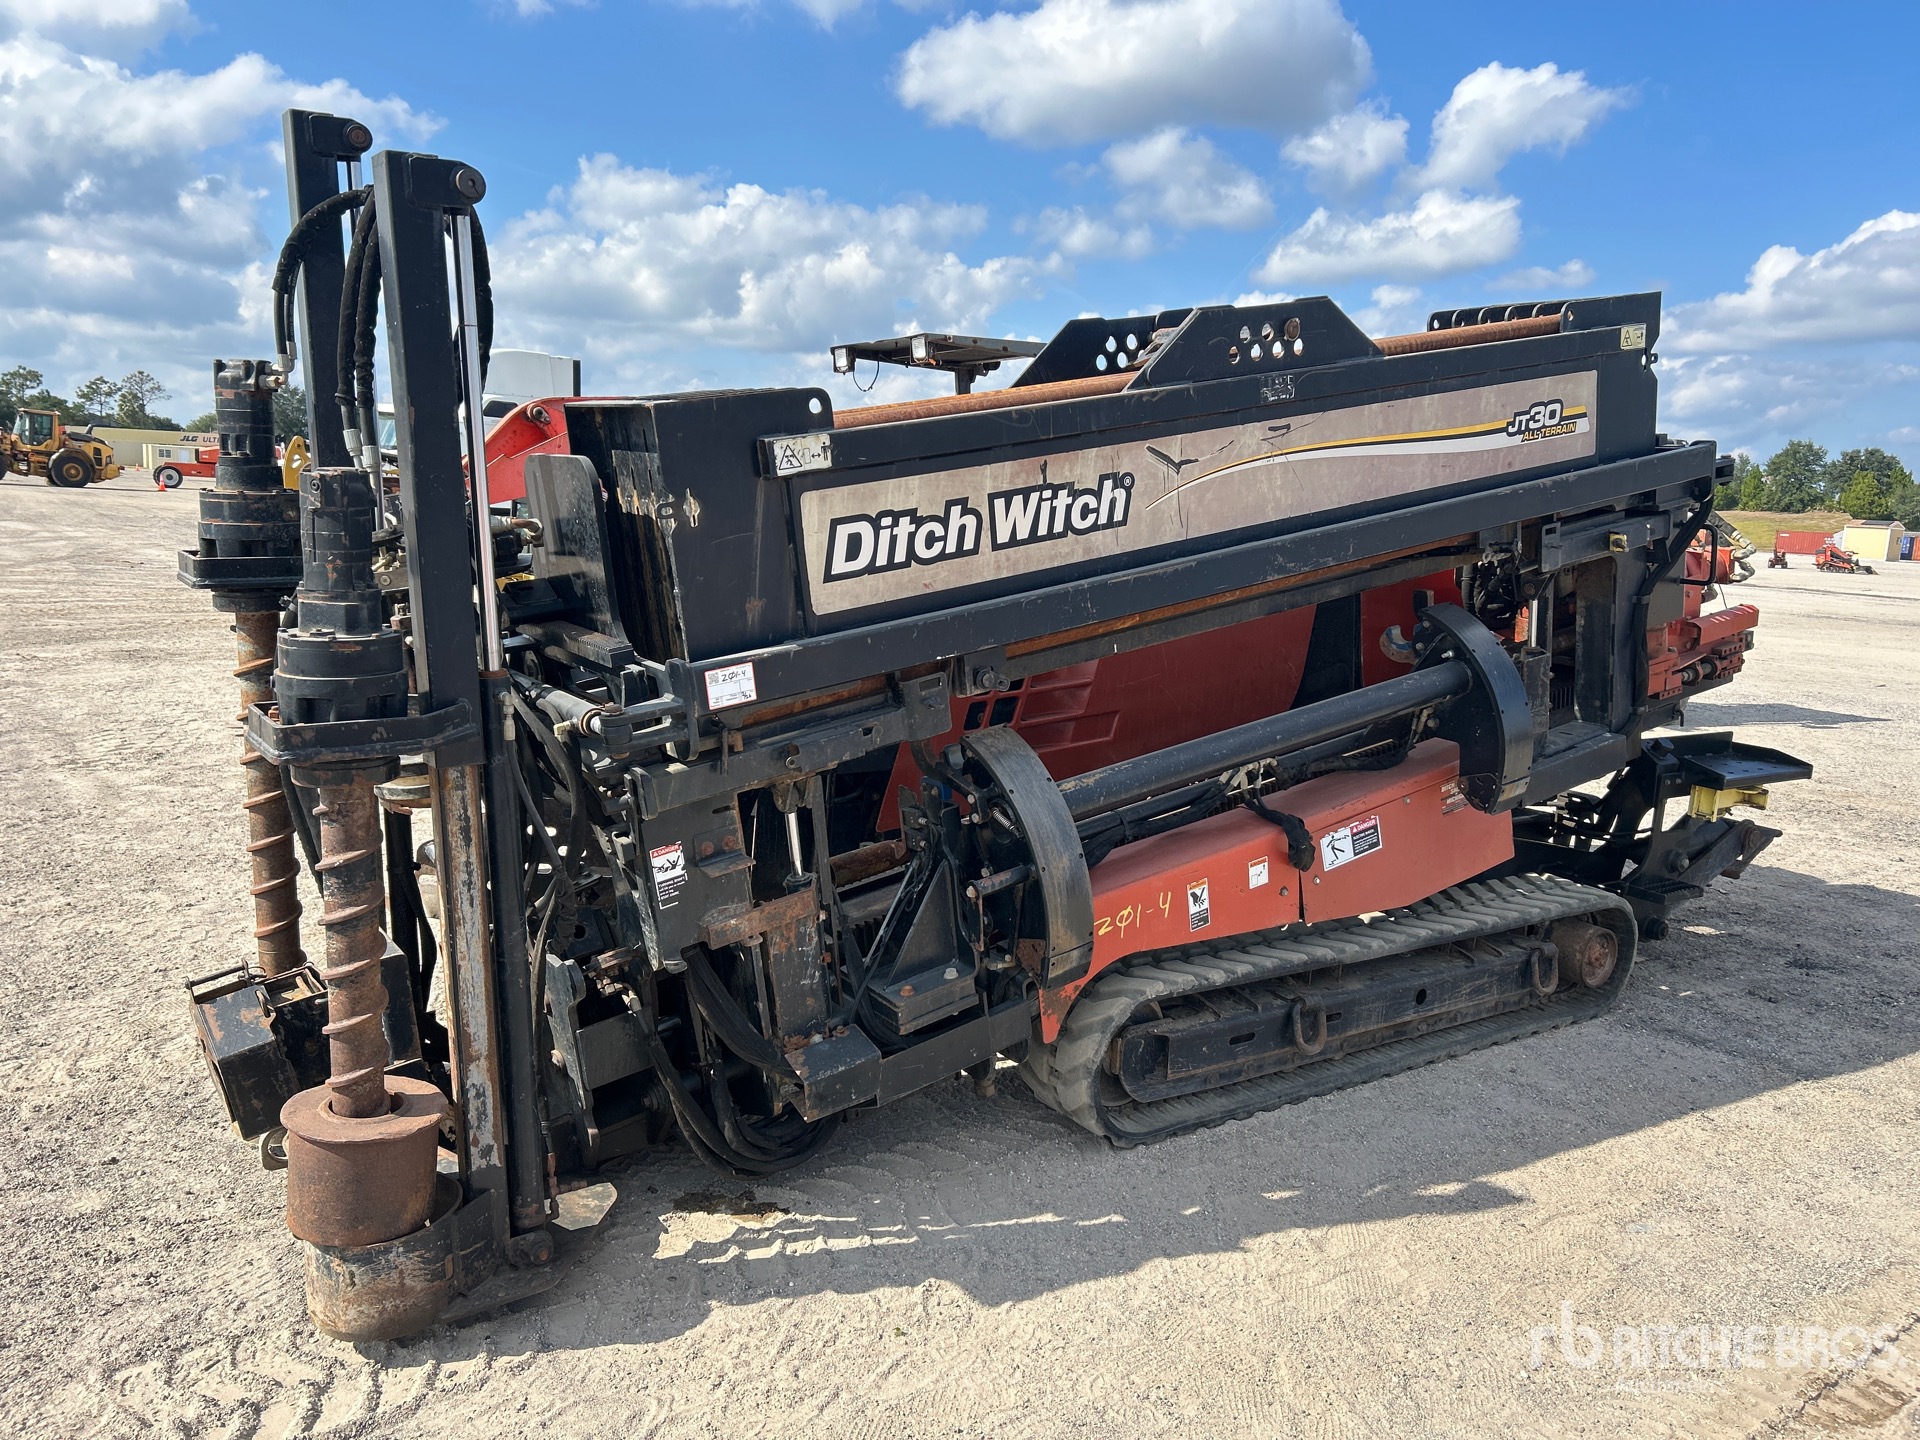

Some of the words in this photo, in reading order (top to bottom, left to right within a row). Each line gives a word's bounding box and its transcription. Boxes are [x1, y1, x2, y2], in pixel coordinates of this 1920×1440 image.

[1508, 402, 1562, 433] JT30
[1522, 421, 1577, 441] ALL-TERRAIN
[829, 503, 978, 576] Ditch
[1356, 819, 1377, 832] DANGER
[657, 845, 680, 856] DANGER
